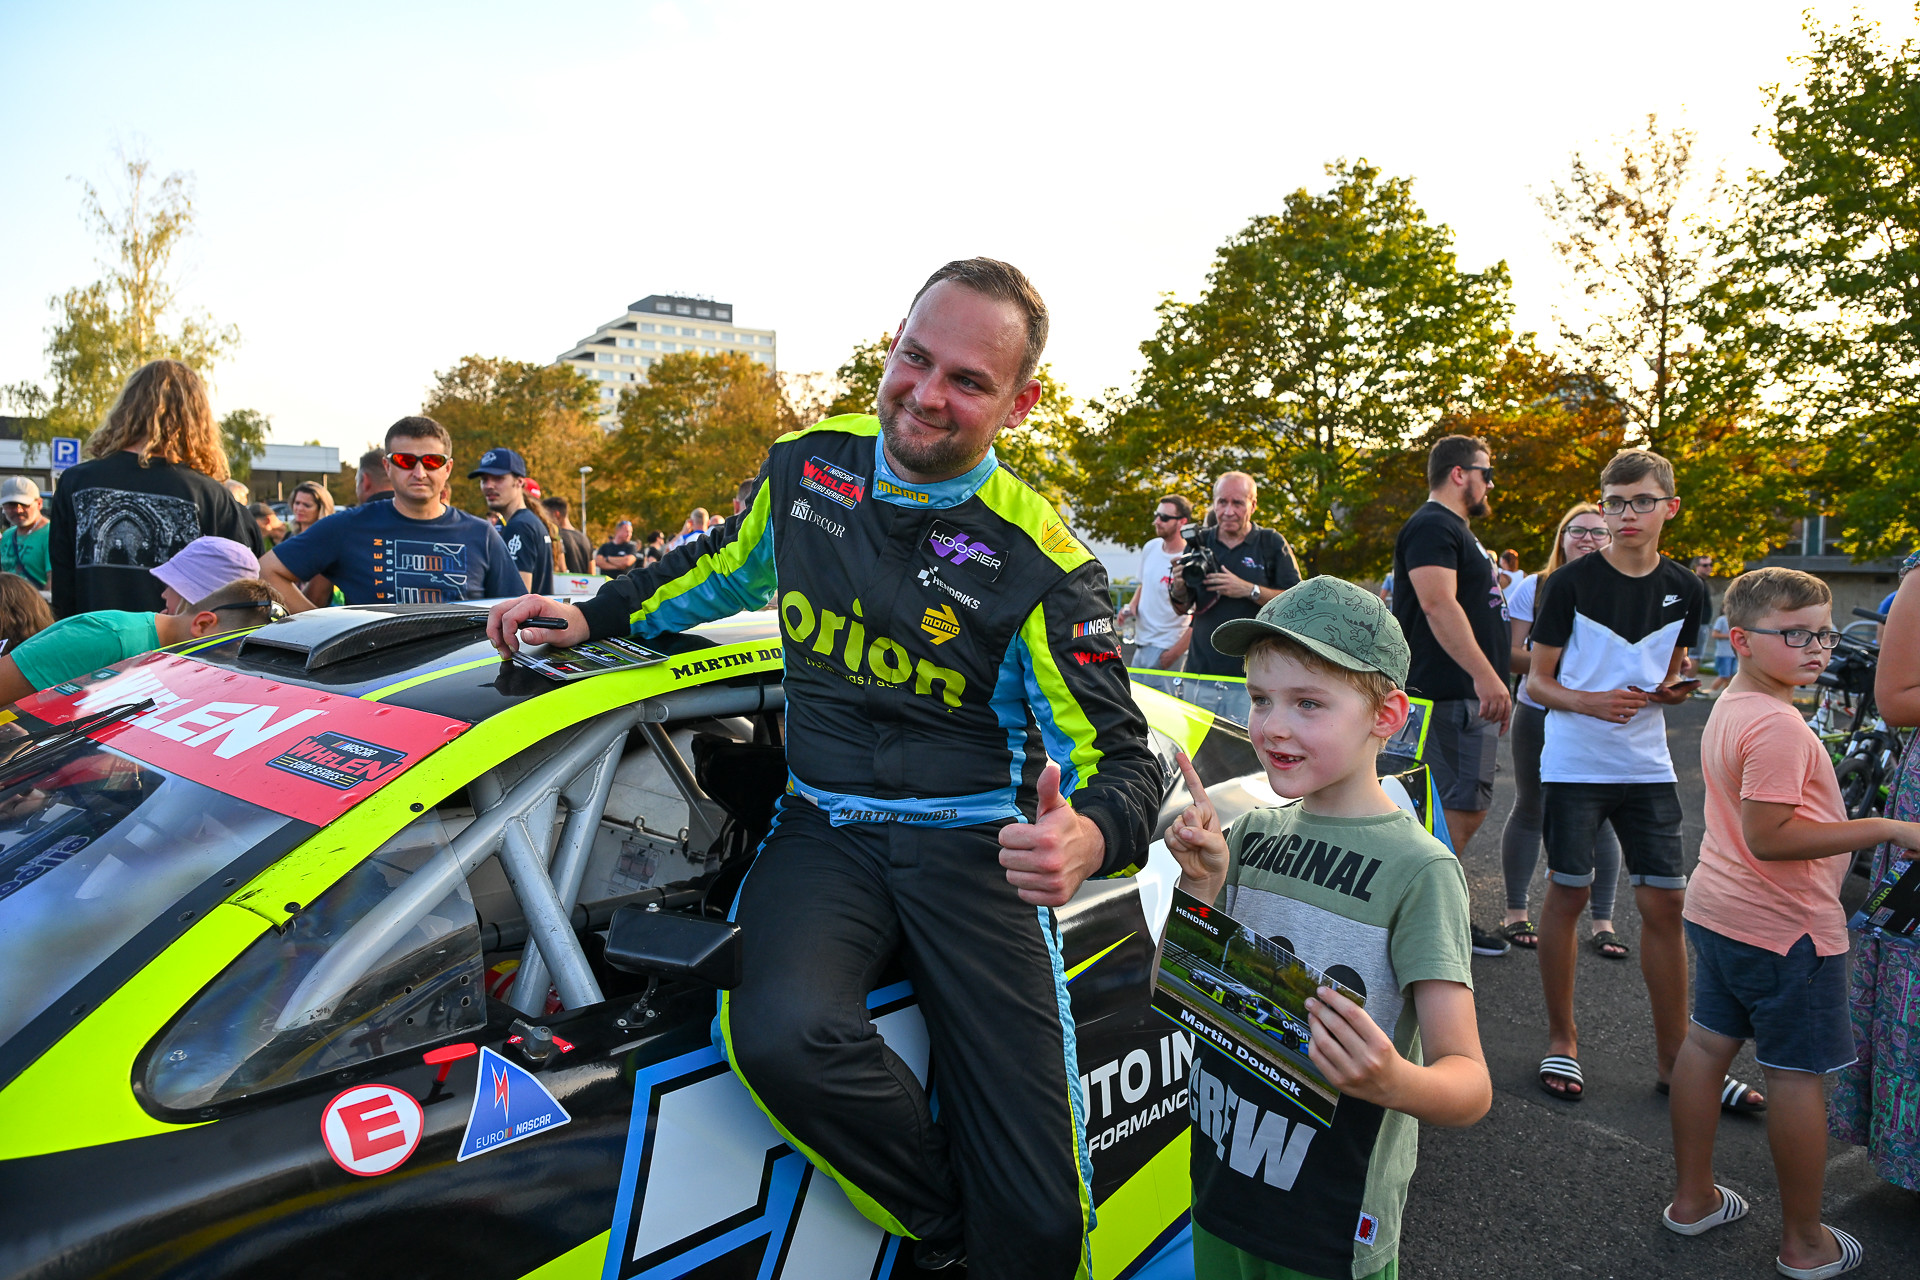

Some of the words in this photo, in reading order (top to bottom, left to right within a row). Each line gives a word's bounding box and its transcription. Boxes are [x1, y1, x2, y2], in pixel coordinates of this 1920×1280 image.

[57, 441, 75, 461] P
[804, 460, 866, 503] WHELEN
[811, 481, 826, 493] EURO
[824, 487, 845, 502] SERIES
[829, 467, 854, 483] NASCAR
[930, 530, 1002, 570] HOOSIER
[932, 575, 981, 610] HENDRIKS
[921, 614, 961, 636] momo
[670, 649, 754, 680] MARTIN
[781, 590, 967, 707] orion
[287, 737, 399, 781] WHELEN
[838, 808, 900, 822] MARTIN
[901, 809, 959, 823] DOUBEK
[1175, 906, 1219, 936] HENDRIKS
[563, 1044, 573, 1052] ON
[1180, 1008, 1233, 1051] Martin
[1235, 1045, 1302, 1098] Doubek
[336, 1093, 407, 1162] E
[476, 1130, 504, 1149] EURO
[515, 1113, 552, 1136] NASCAR
